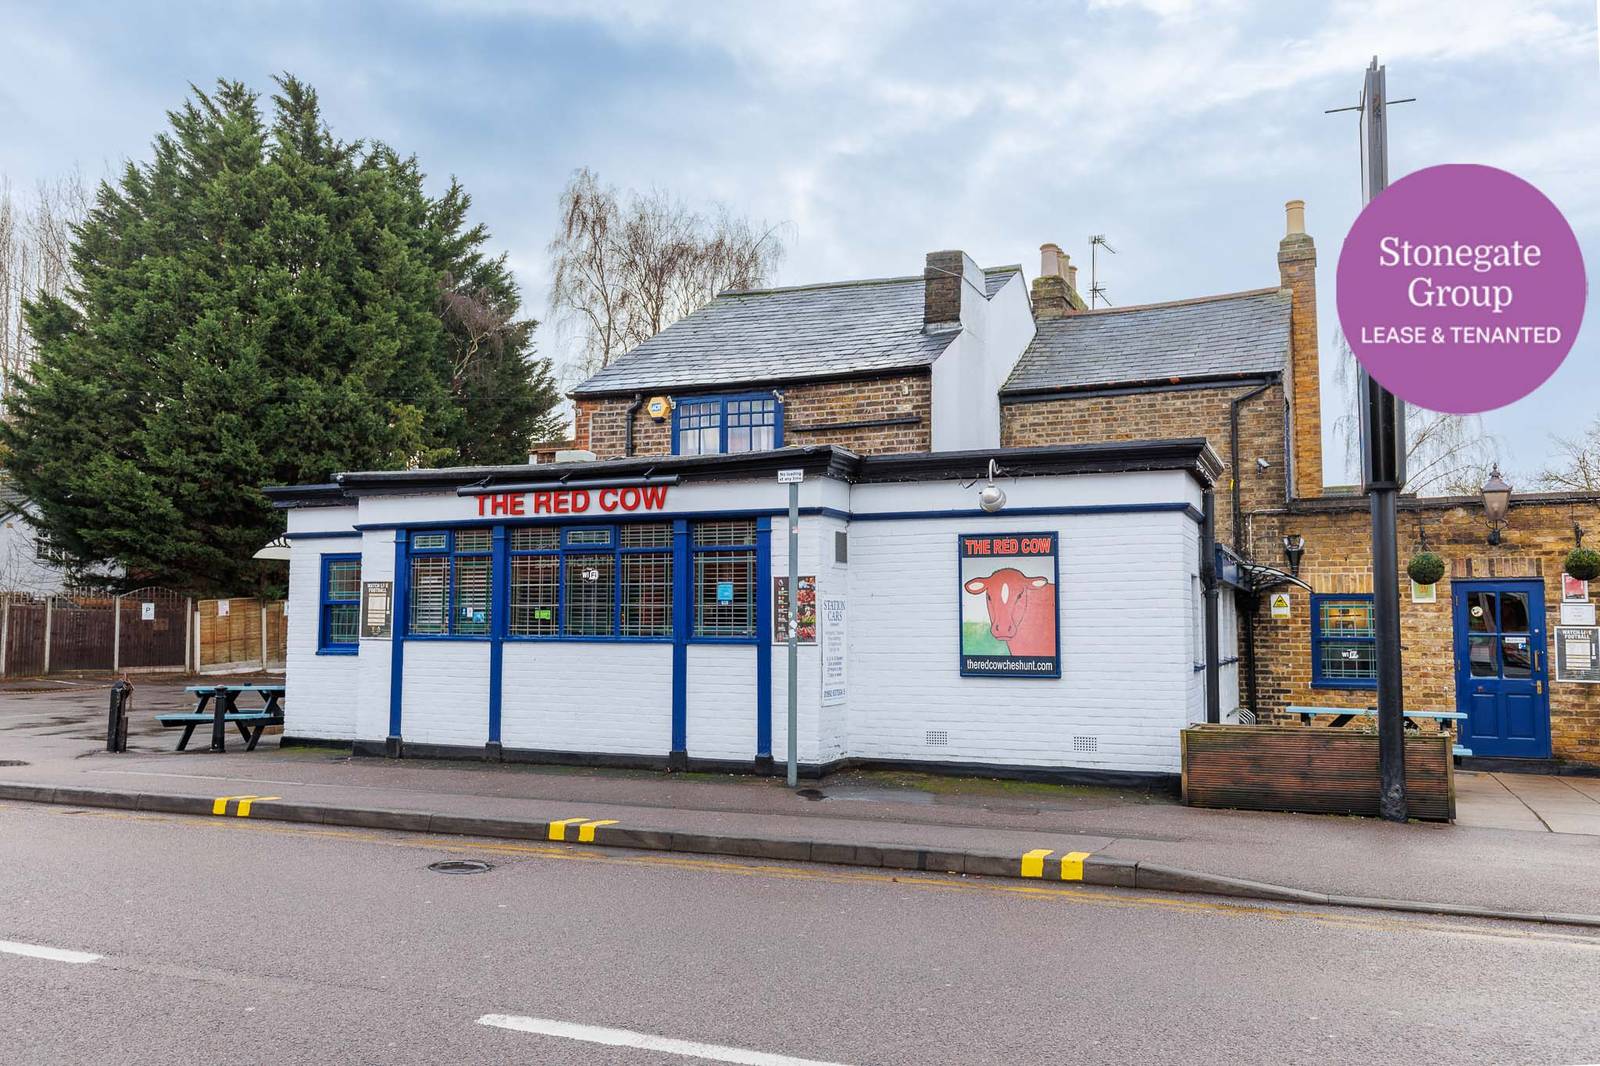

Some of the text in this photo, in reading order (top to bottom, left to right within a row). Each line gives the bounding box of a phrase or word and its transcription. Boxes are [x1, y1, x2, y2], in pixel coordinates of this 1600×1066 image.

[476, 484, 668, 516] THE RED COW
[965, 537, 1051, 554] THE RED COW
[823, 600, 846, 611] STATION
[827, 611, 843, 621] CARS
[966, 659, 1053, 671] theredcowcheshunt.com
